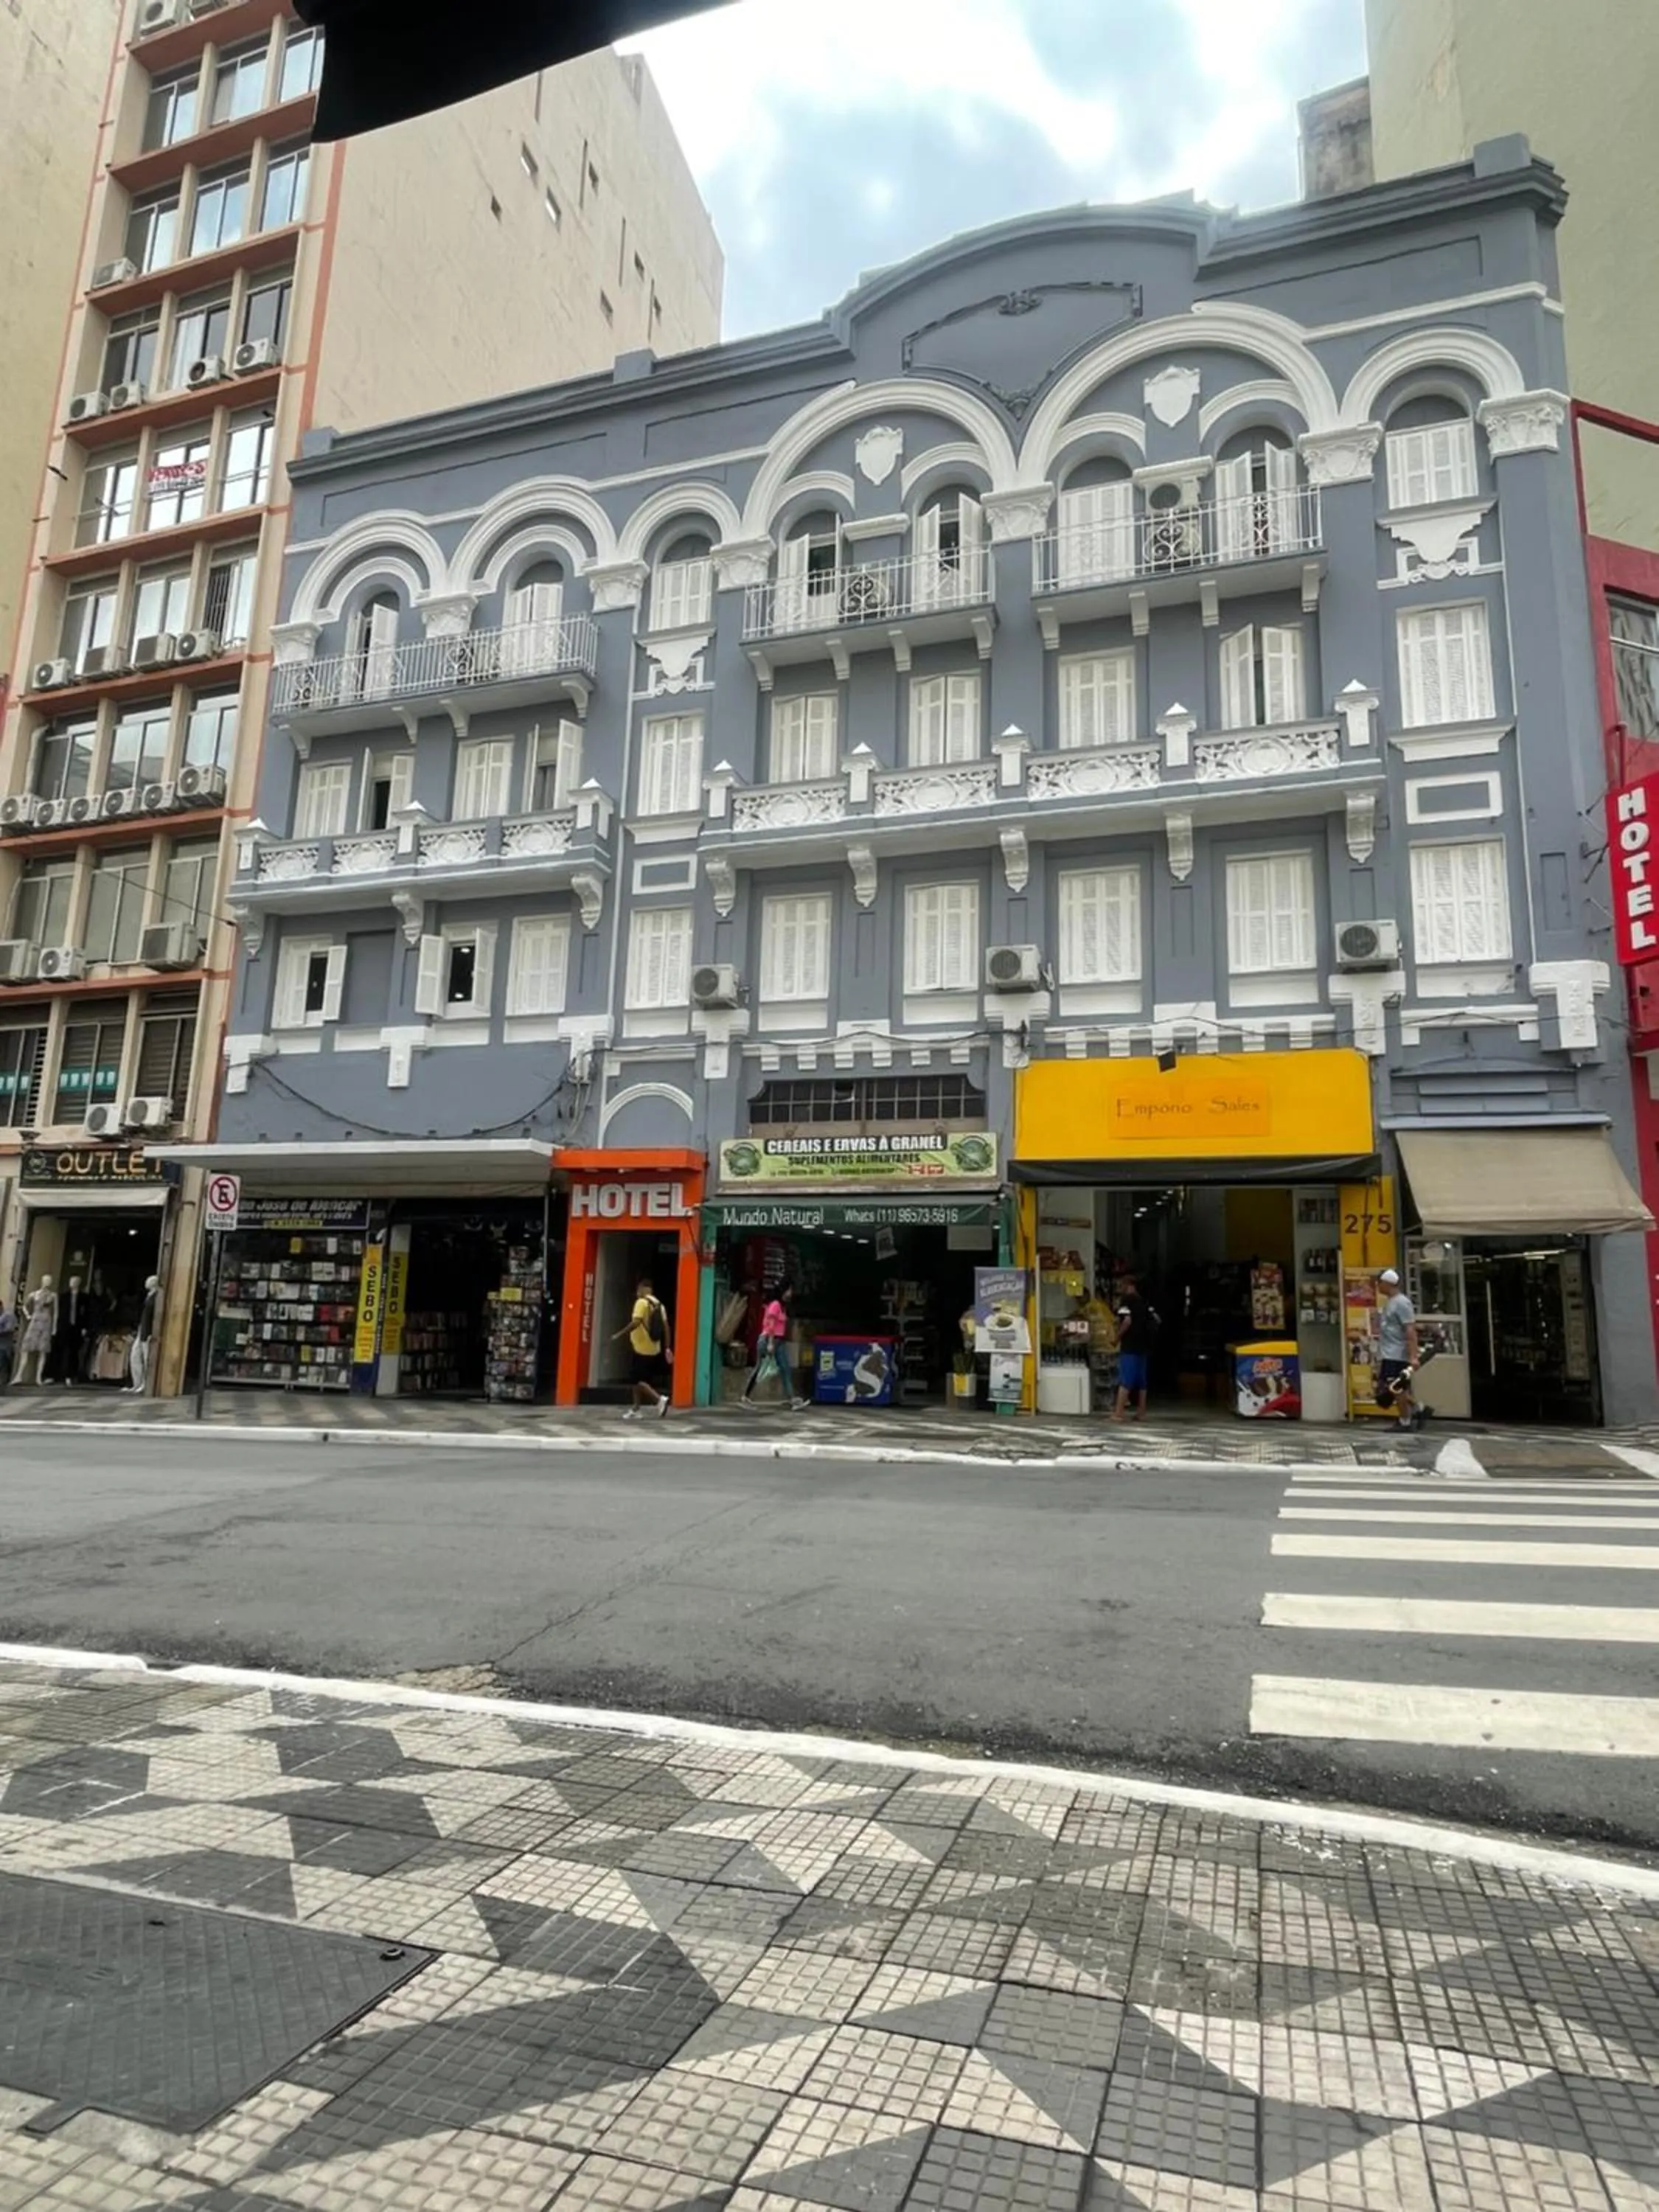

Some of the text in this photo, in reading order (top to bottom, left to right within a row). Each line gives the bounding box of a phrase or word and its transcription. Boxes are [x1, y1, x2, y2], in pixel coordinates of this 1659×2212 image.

[1618, 787, 1656, 950] HOTEL
[1208, 1095, 1260, 1114] Sales
[768, 1139, 818, 1153] CEREAIS
[824, 1138, 831, 1152] E
[834, 1138, 876, 1152] ERVAS
[891, 1135, 944, 1151] GRANEL
[787, 1153, 921, 1166] SUPLEMENTOS ALIMENTARES
[571, 1183, 691, 1217] HOTEL
[723, 1207, 768, 1225] Mundo
[772, 1206, 824, 1225] Natural
[843, 1208, 874, 1222] Whats
[877, 1208, 897, 1222] (11)
[1344, 1214, 1392, 1234] 275
[363, 1265, 378, 1322] SEBO
[389, 1256, 401, 1314] SEBO
[582, 1273, 594, 1342] HOTEL
